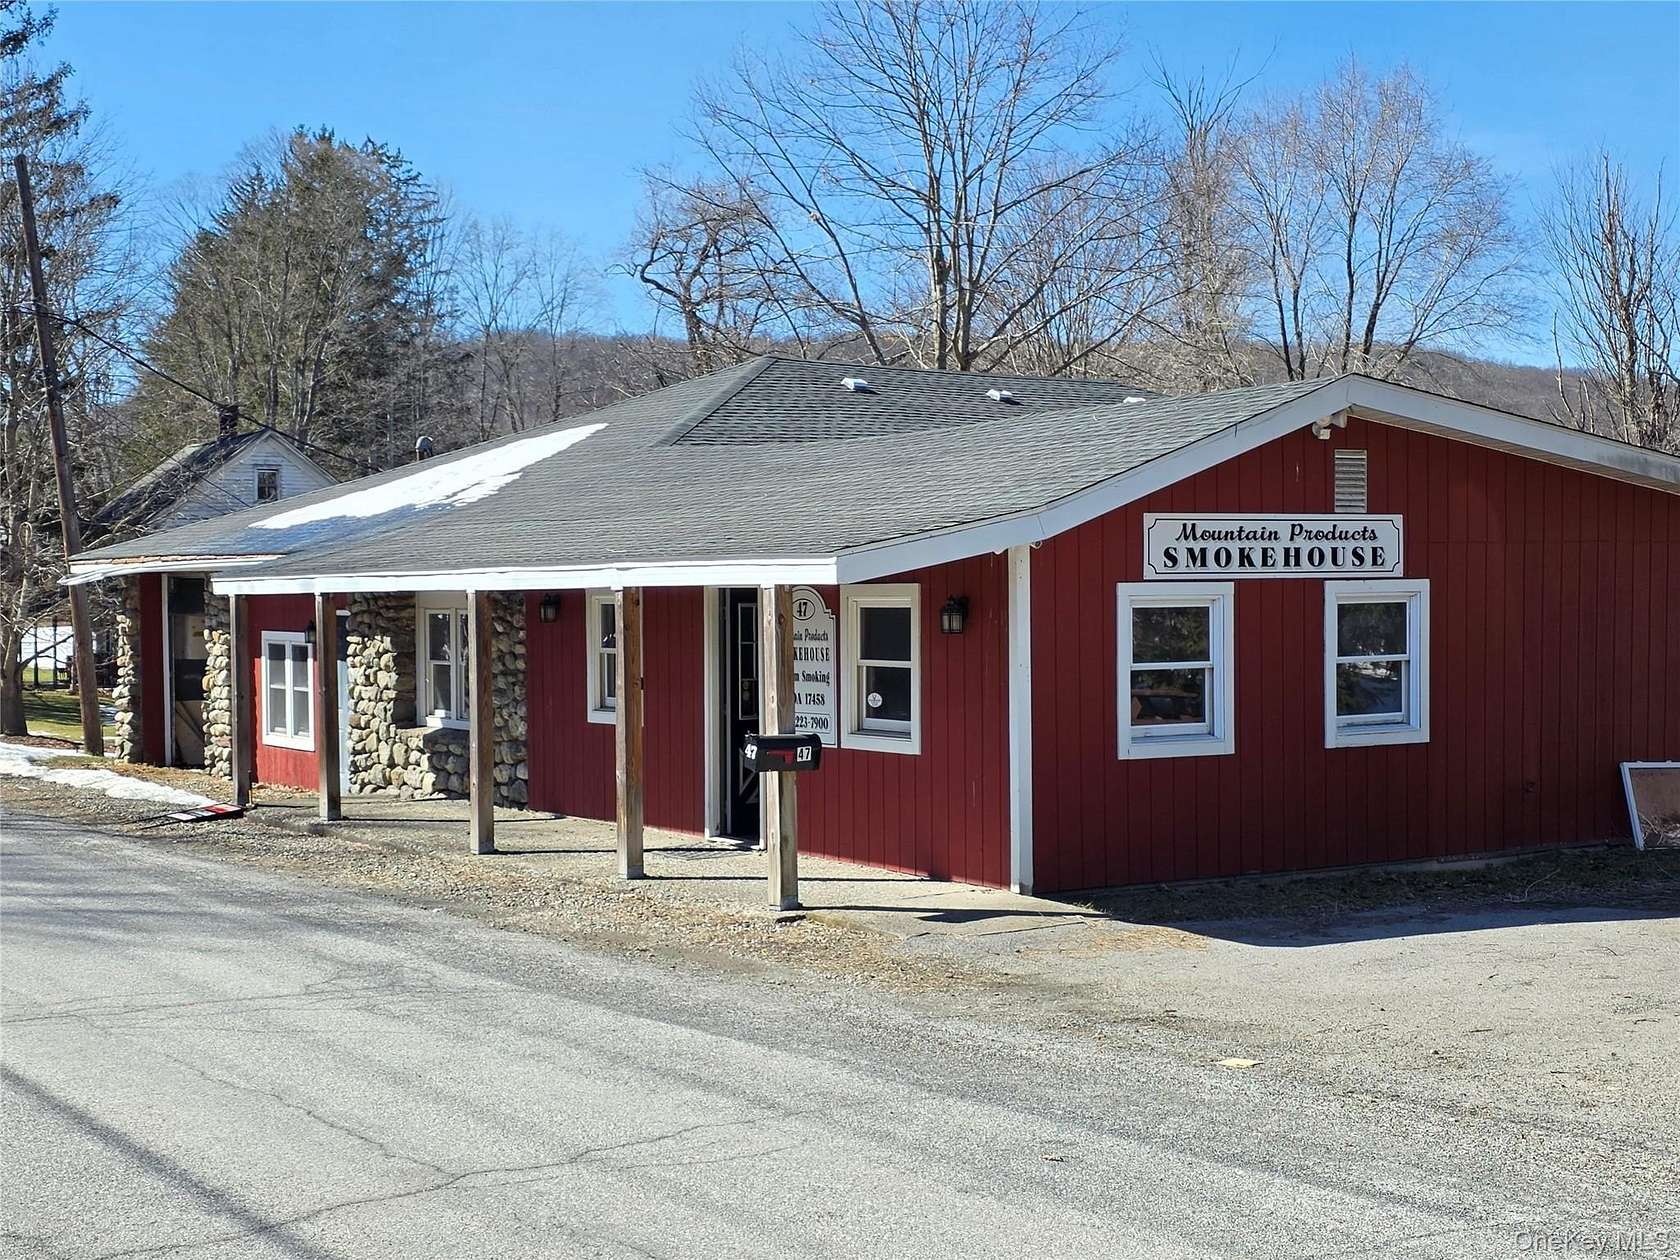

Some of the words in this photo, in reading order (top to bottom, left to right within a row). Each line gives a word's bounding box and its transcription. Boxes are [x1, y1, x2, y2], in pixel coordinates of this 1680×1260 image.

[1174, 522, 1281, 542] Mountain
[1288, 522, 1378, 542] Products
[1163, 546, 1386, 569] SMOKEHOUSE
[796, 601, 808, 617] 47
[804, 628, 829, 641] Products
[793, 646, 830, 661] KEHOUSE
[802, 670, 830, 686] Smoking
[805, 692, 826, 706] 17458
[744, 743, 758, 760] 47
[798, 747, 811, 761] 47
